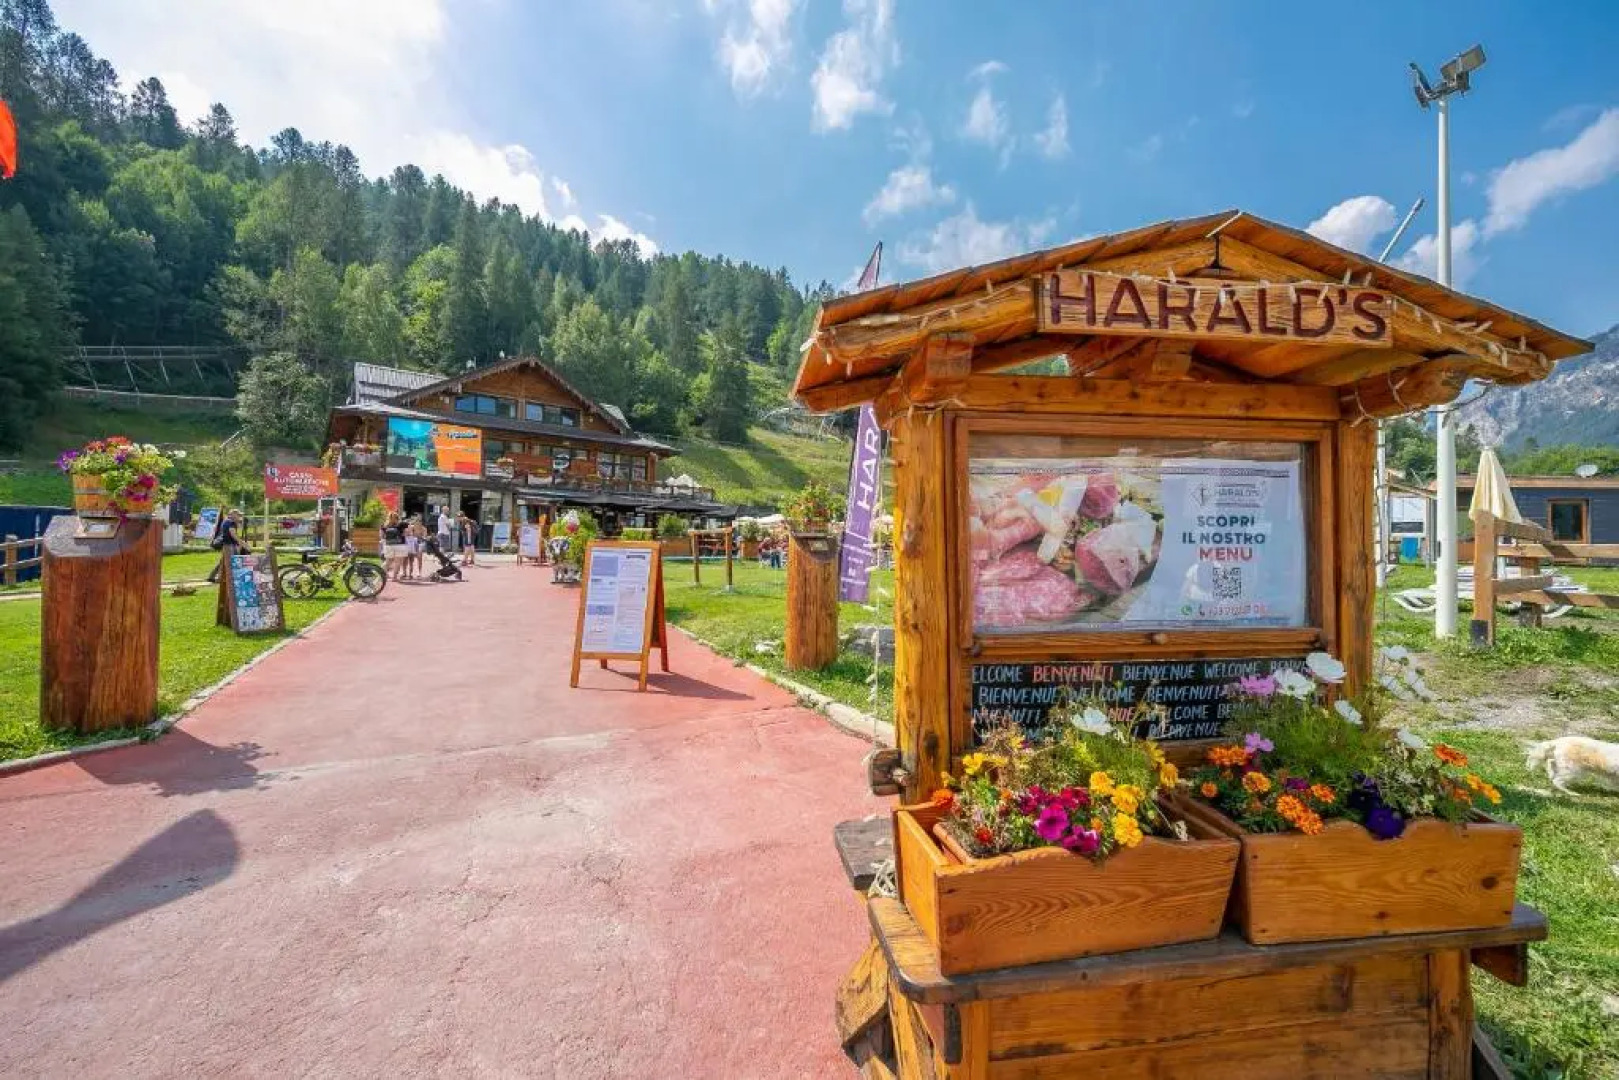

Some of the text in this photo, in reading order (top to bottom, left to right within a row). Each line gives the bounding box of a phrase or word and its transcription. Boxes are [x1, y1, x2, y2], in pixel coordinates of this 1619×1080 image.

[1050, 273, 1387, 340] HARALD'S
[1197, 516, 1255, 528] SCOPRI
[1182, 532, 1266, 545] IL NOSTRO
[1200, 547, 1253, 561] MENU
[1123, 664, 1195, 681] BIENVENUE
[1204, 661, 1261, 679] WELCOME
[979, 686, 1057, 704] BIENVENUE
[1147, 685, 1221, 703] BENVENUTI
